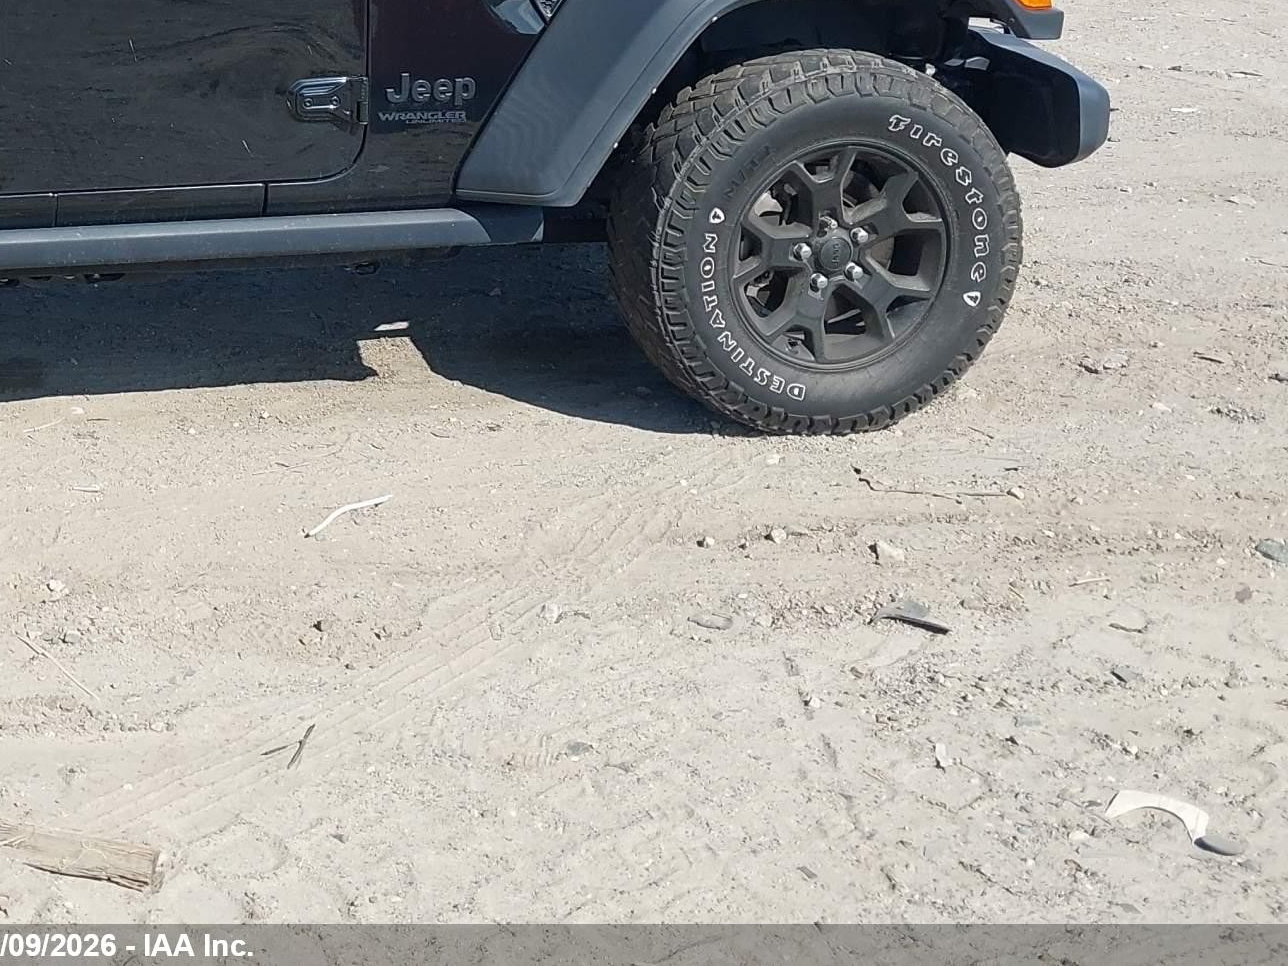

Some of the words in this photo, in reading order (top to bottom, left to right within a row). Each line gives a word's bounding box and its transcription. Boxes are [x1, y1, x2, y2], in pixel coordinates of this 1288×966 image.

[377, 111, 466, 121] WRANGLER
[385, 73, 476, 106] Jeep
[888, 116, 991, 283] Firestone
[700, 234, 806, 401] DESTINATION
